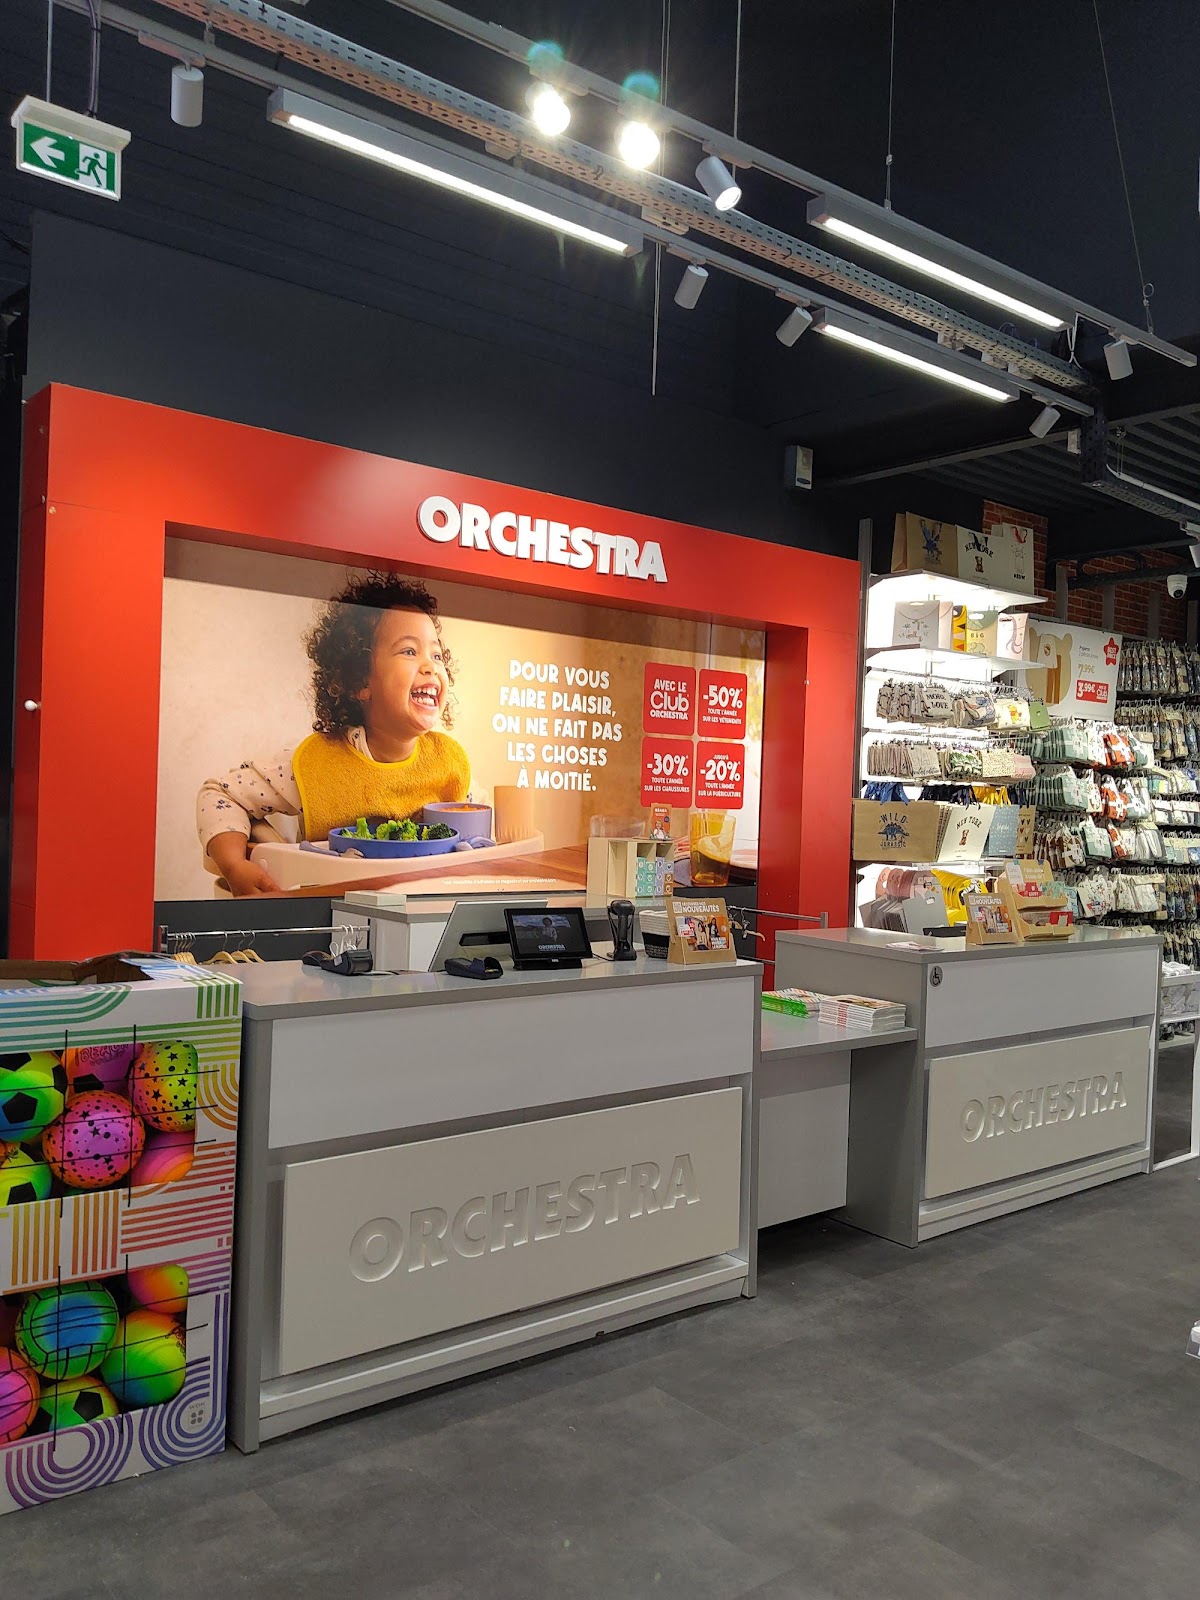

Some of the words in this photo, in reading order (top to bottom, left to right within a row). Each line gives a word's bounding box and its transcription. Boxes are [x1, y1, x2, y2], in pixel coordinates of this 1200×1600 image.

[417, 494, 668, 584] ORCHESTRA
[509, 659, 559, 684] POUR
[564, 666, 610, 690] VOUS
[654, 679, 676, 692] AVEC
[678, 681, 687, 692] LE
[499, 686, 547, 710] FAIRE
[551, 691, 616, 718] PLAISIR,
[650, 691, 689, 712] Club
[650, 709, 688, 720] ORCHESTRA
[707, 708, 721, 716] TOUTE
[702, 715, 711, 723] SUR
[711, 716, 719, 724] LES
[491, 713, 521, 734] ON
[525, 717, 549, 737] NE
[554, 718, 588, 739] FAIT
[591, 721, 622, 742] PAS
[507, 741, 536, 763] LES
[541, 744, 608, 767] CHOSES
[516, 764, 529, 789] À
[534, 769, 597, 792] MOITIÉ.
[651, 776, 666, 785] TOUTE
[705, 781, 718, 789] TOUTE
[880, 813, 906, 824] WILD
[956, 817, 967, 829] NEW
[968, 815, 982, 828] YORK
[880, 838, 907, 848] JURASSIC
[682, 904, 720, 913] NOUVEAUTÉS
[961, 1071, 1127, 1142] ORCHESTRA
[350, 1153, 700, 1283] ORCHESTRA
